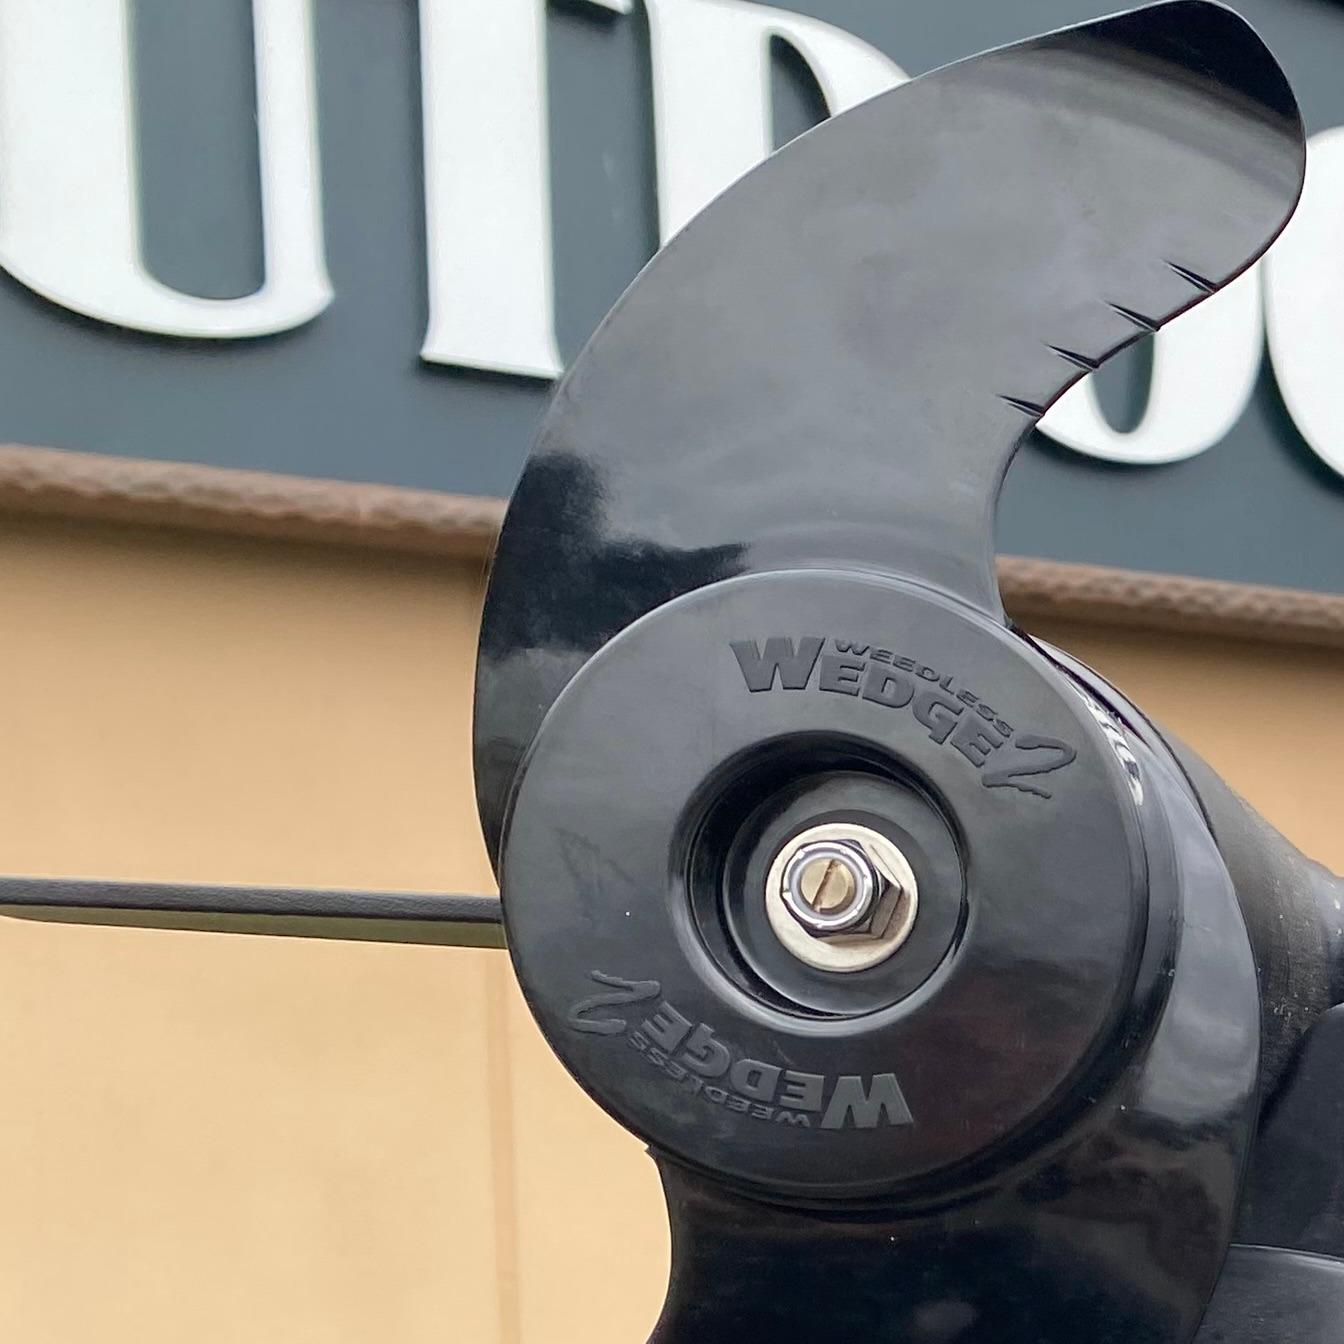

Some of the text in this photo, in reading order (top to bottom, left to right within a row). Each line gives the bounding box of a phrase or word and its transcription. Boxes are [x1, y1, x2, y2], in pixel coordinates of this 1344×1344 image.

[729, 637, 1004, 769] WEDGE
[834, 638, 1014, 738] WEEDLESS
[626, 1029, 811, 1129] WEEDLESS
[643, 1000, 914, 1130] WEDGE
